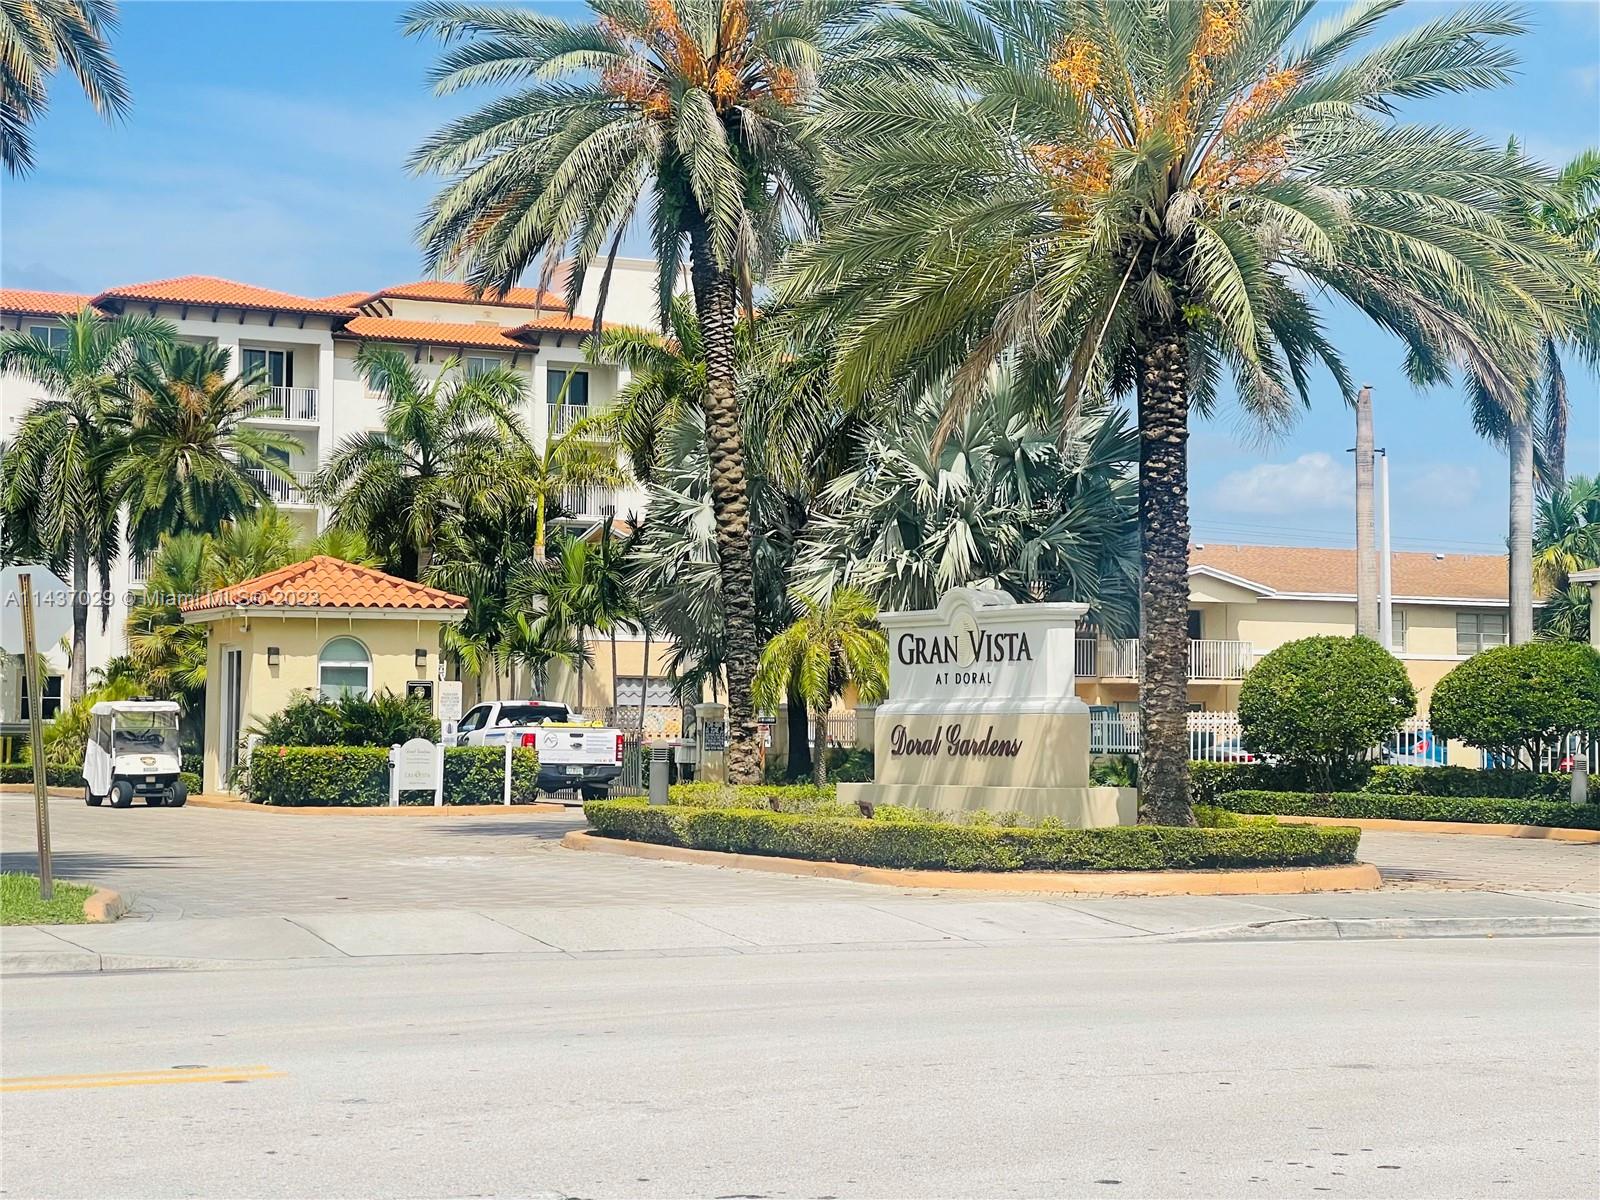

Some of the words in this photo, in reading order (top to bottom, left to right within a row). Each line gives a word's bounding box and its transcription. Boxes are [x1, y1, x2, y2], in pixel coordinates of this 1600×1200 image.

[897, 633, 959, 665] GRAN
[967, 630, 1033, 662] VISTA
[935, 673, 949, 685] AT
[955, 672, 992, 684] DORAL
[890, 724, 942, 757] Doral
[945, 724, 1022, 757] Gardens
